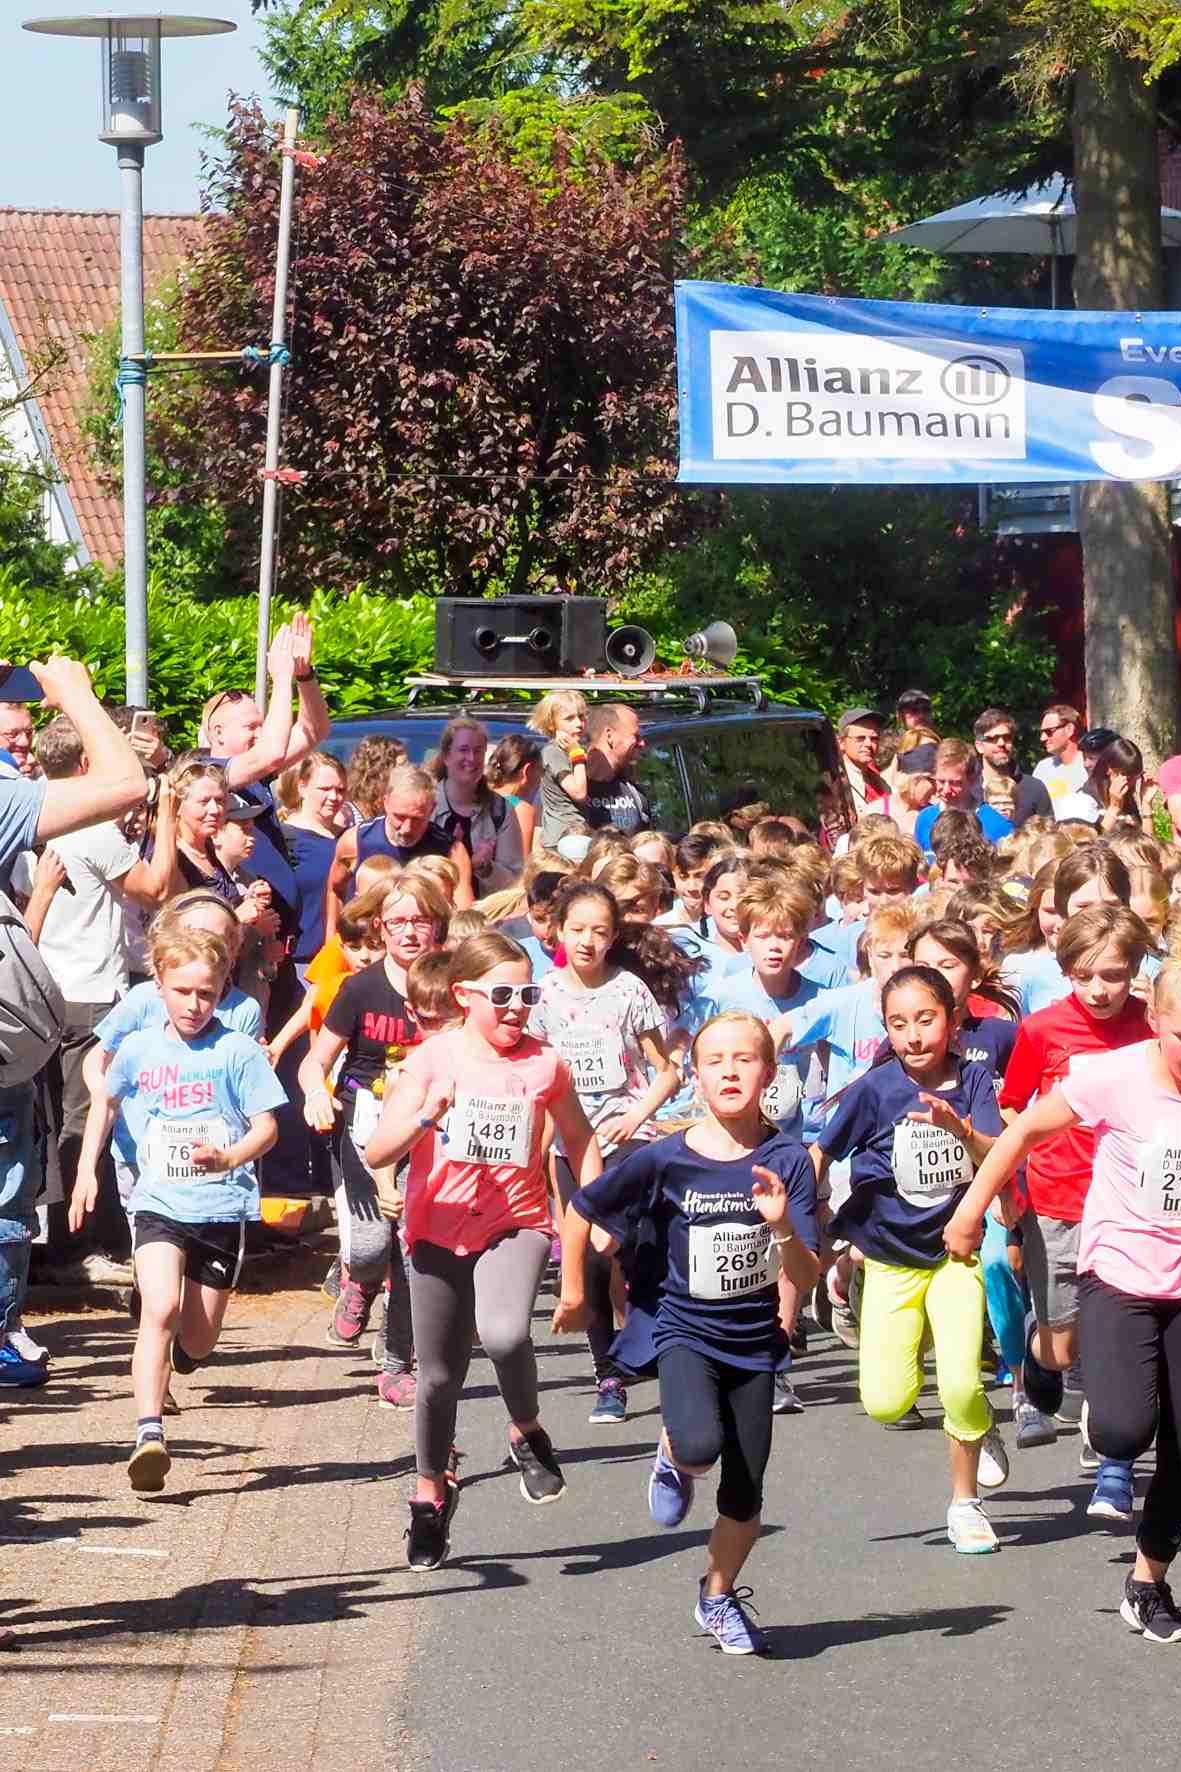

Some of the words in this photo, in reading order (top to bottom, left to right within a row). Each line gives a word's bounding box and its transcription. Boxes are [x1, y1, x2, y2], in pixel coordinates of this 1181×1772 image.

[726, 355, 924, 396] Allianz
[727, 402, 772, 438] D.
[786, 401, 1010, 440] Baumann
[590, 795, 636, 809] eebok
[138, 1064, 181, 1094] RUN
[577, 1075, 606, 1087] runs
[469, 1099, 506, 1111] Allianz
[468, 1121, 516, 1141] 1481
[168, 1144, 200, 1161] 76
[467, 1140, 513, 1160] bruns
[915, 1145, 964, 1167] 1010
[918, 1167, 962, 1185] bruns
[713, 1230, 757, 1242] Allianz
[721, 1268, 768, 1292] bruns
